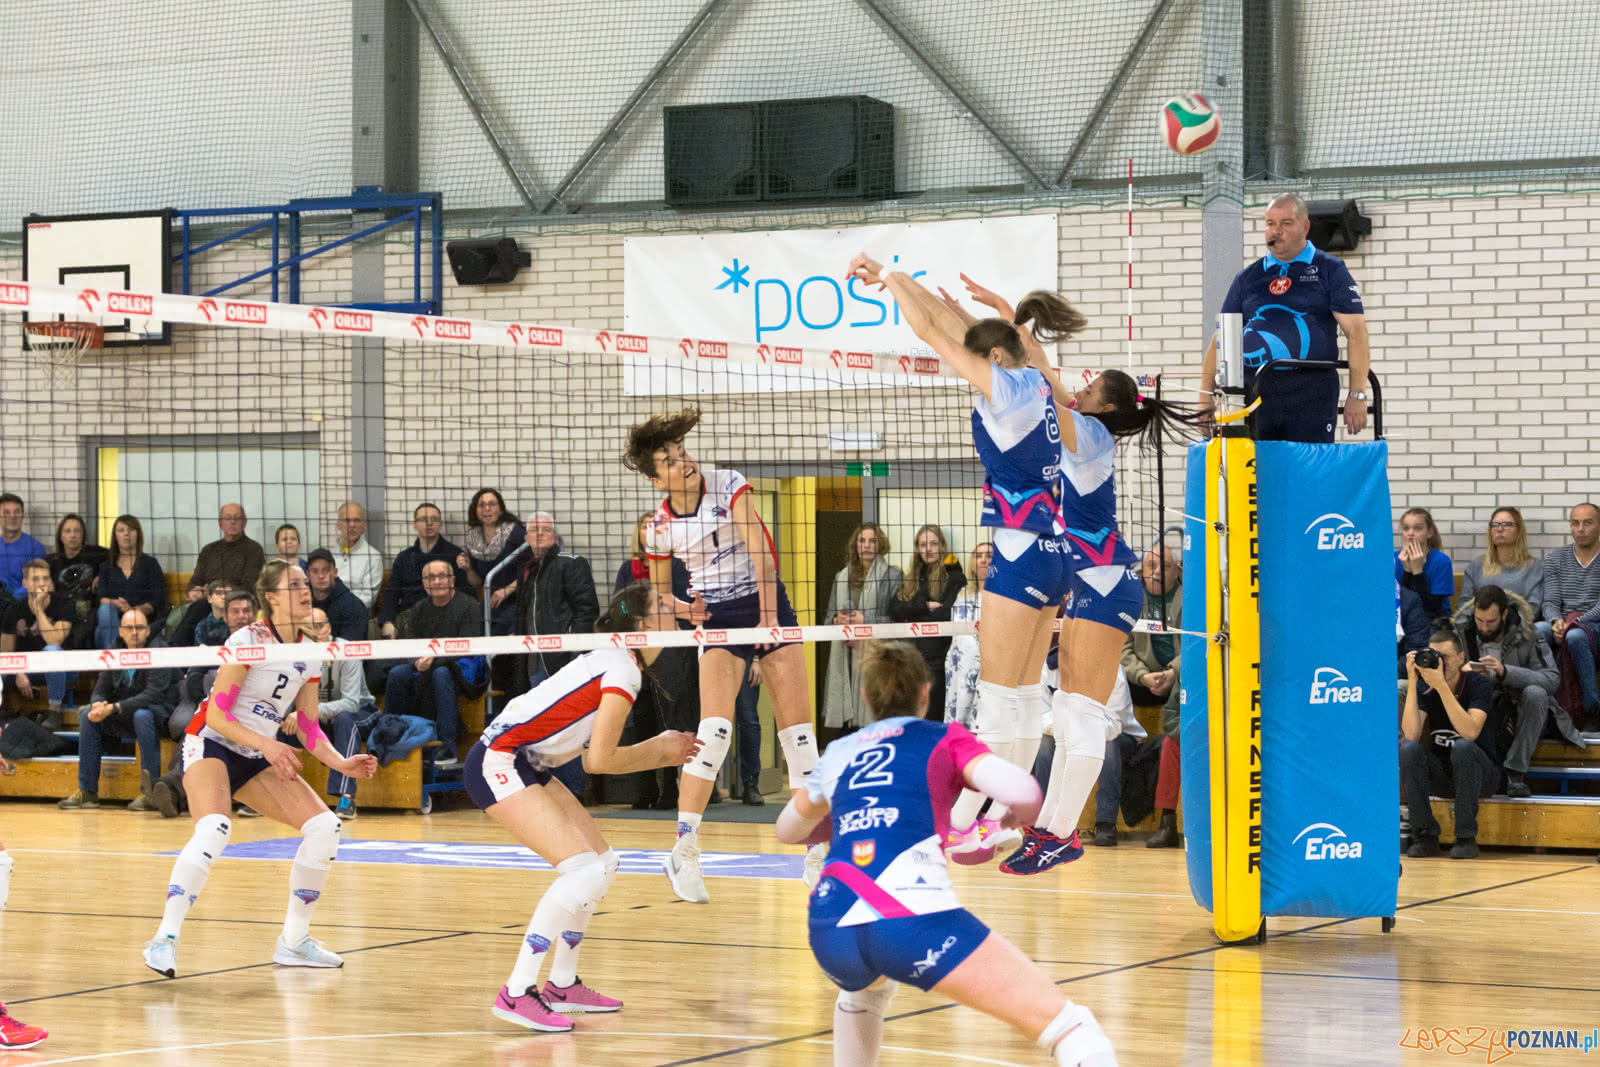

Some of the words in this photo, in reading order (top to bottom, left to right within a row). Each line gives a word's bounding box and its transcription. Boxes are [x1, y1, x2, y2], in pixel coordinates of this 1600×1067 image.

[0, 285, 27, 304] LEN
[109, 294, 152, 314] ORLEN
[226, 304, 266, 322] ORLEN
[335, 312, 371, 330] ORLEN
[436, 320, 471, 338] ORLEN
[529, 329, 562, 345] ORLEN
[617, 336, 647, 351] ORLEN
[699, 342, 727, 357] ORLEN
[776, 348, 802, 363] ORLEN
[848, 354, 872, 369] ORLEN
[916, 358, 939, 373] ORLEN
[1317, 527, 1364, 550] Enea
[272, 673, 289, 699] 2
[1310, 682, 1363, 704] Enea
[1434, 734, 1456, 747] En
[848, 743, 896, 790] 2
[1305, 838, 1363, 860] Enea
